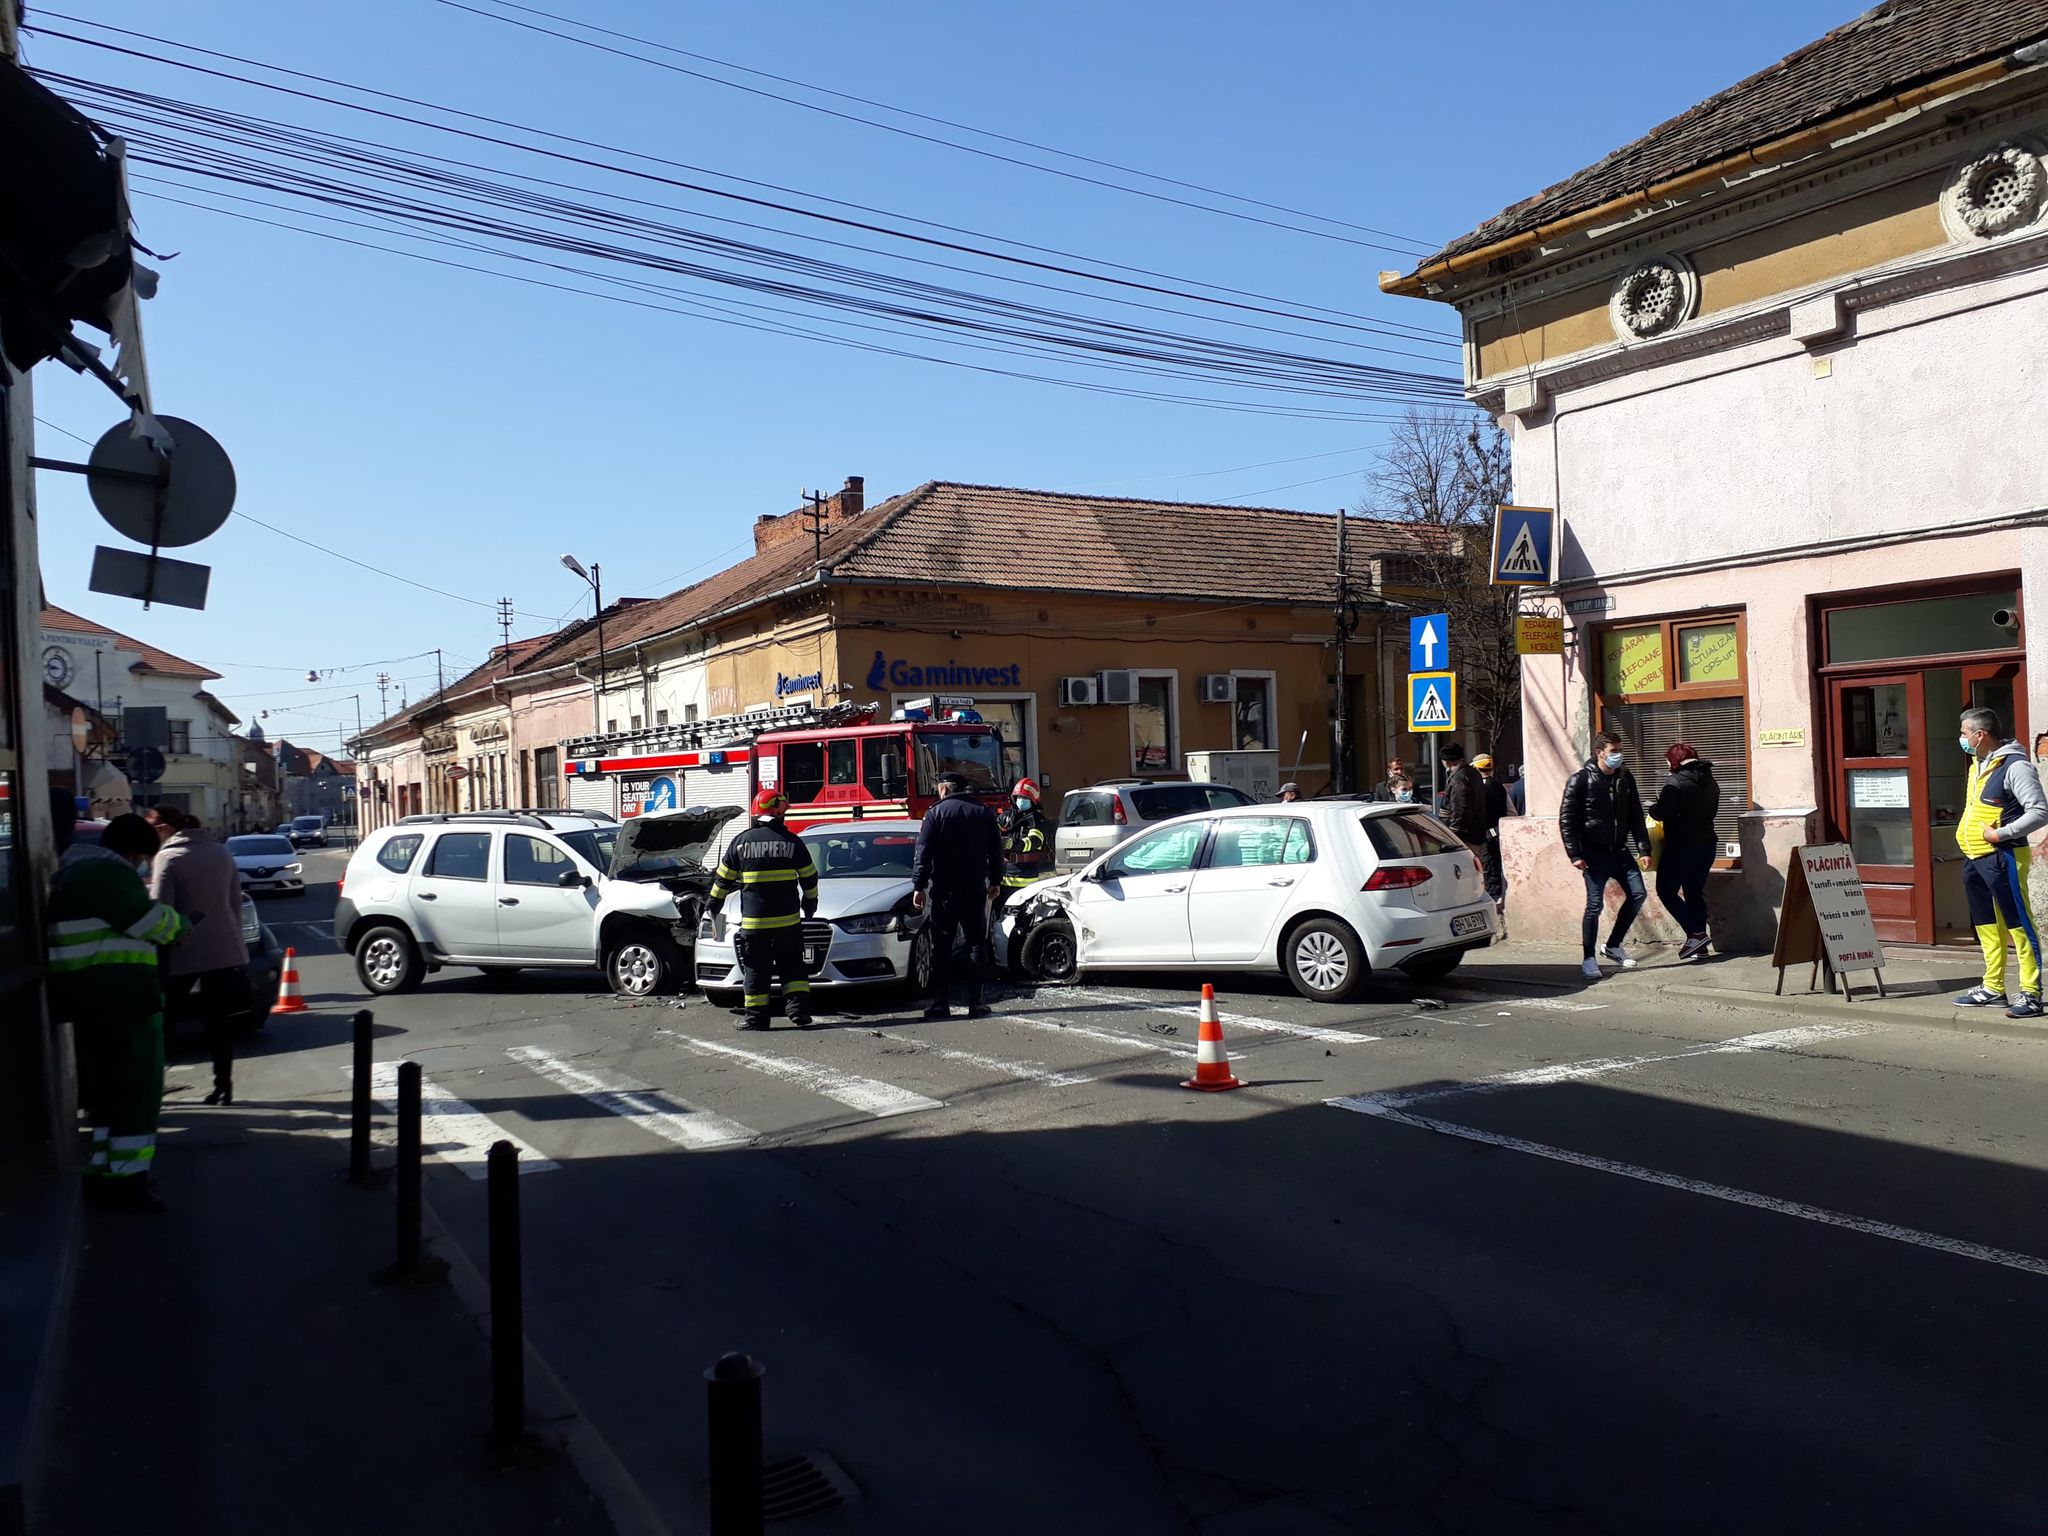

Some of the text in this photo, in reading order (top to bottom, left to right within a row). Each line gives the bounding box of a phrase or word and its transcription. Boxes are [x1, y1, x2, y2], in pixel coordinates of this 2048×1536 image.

[1521, 631, 1560, 641] TELEFOANE
[1530, 642, 1555, 652] MOBILE
[890, 659, 1021, 687] Gaminvest
[782, 671, 822, 695] Gaminvest
[622, 781, 650, 792] IS YOUR
[761, 781, 775, 790] 112
[622, 791, 656, 803] SEATBELT
[622, 803, 637, 813] ON?
